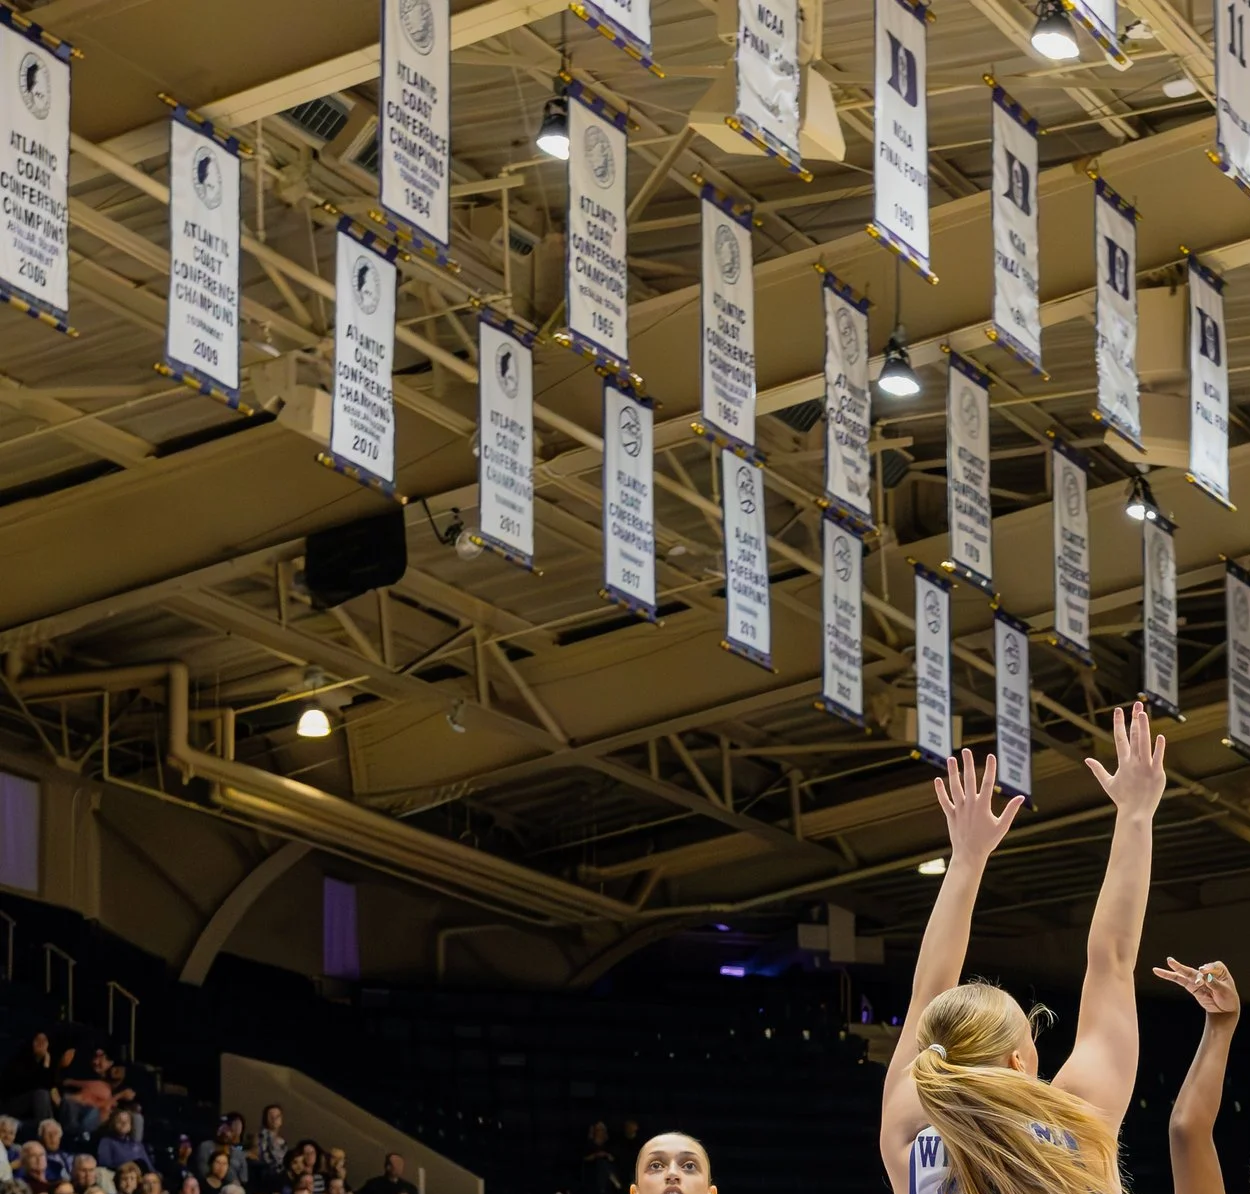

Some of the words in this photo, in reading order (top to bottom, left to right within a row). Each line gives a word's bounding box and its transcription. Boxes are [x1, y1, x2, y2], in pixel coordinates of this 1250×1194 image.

[1228, 3, 1247, 68] 11
[10, 130, 58, 172] ATLANTIC
[17, 157, 51, 189] COAST
[1, 171, 67, 223] CONFERENCE
[3, 196, 65, 244] CHAMPIONS
[183, 220, 229, 258] ATLANTIC
[193, 246, 222, 275] COAST
[174, 259, 236, 307] CONFERENCE
[175, 283, 234, 327] CHAMPIONS
